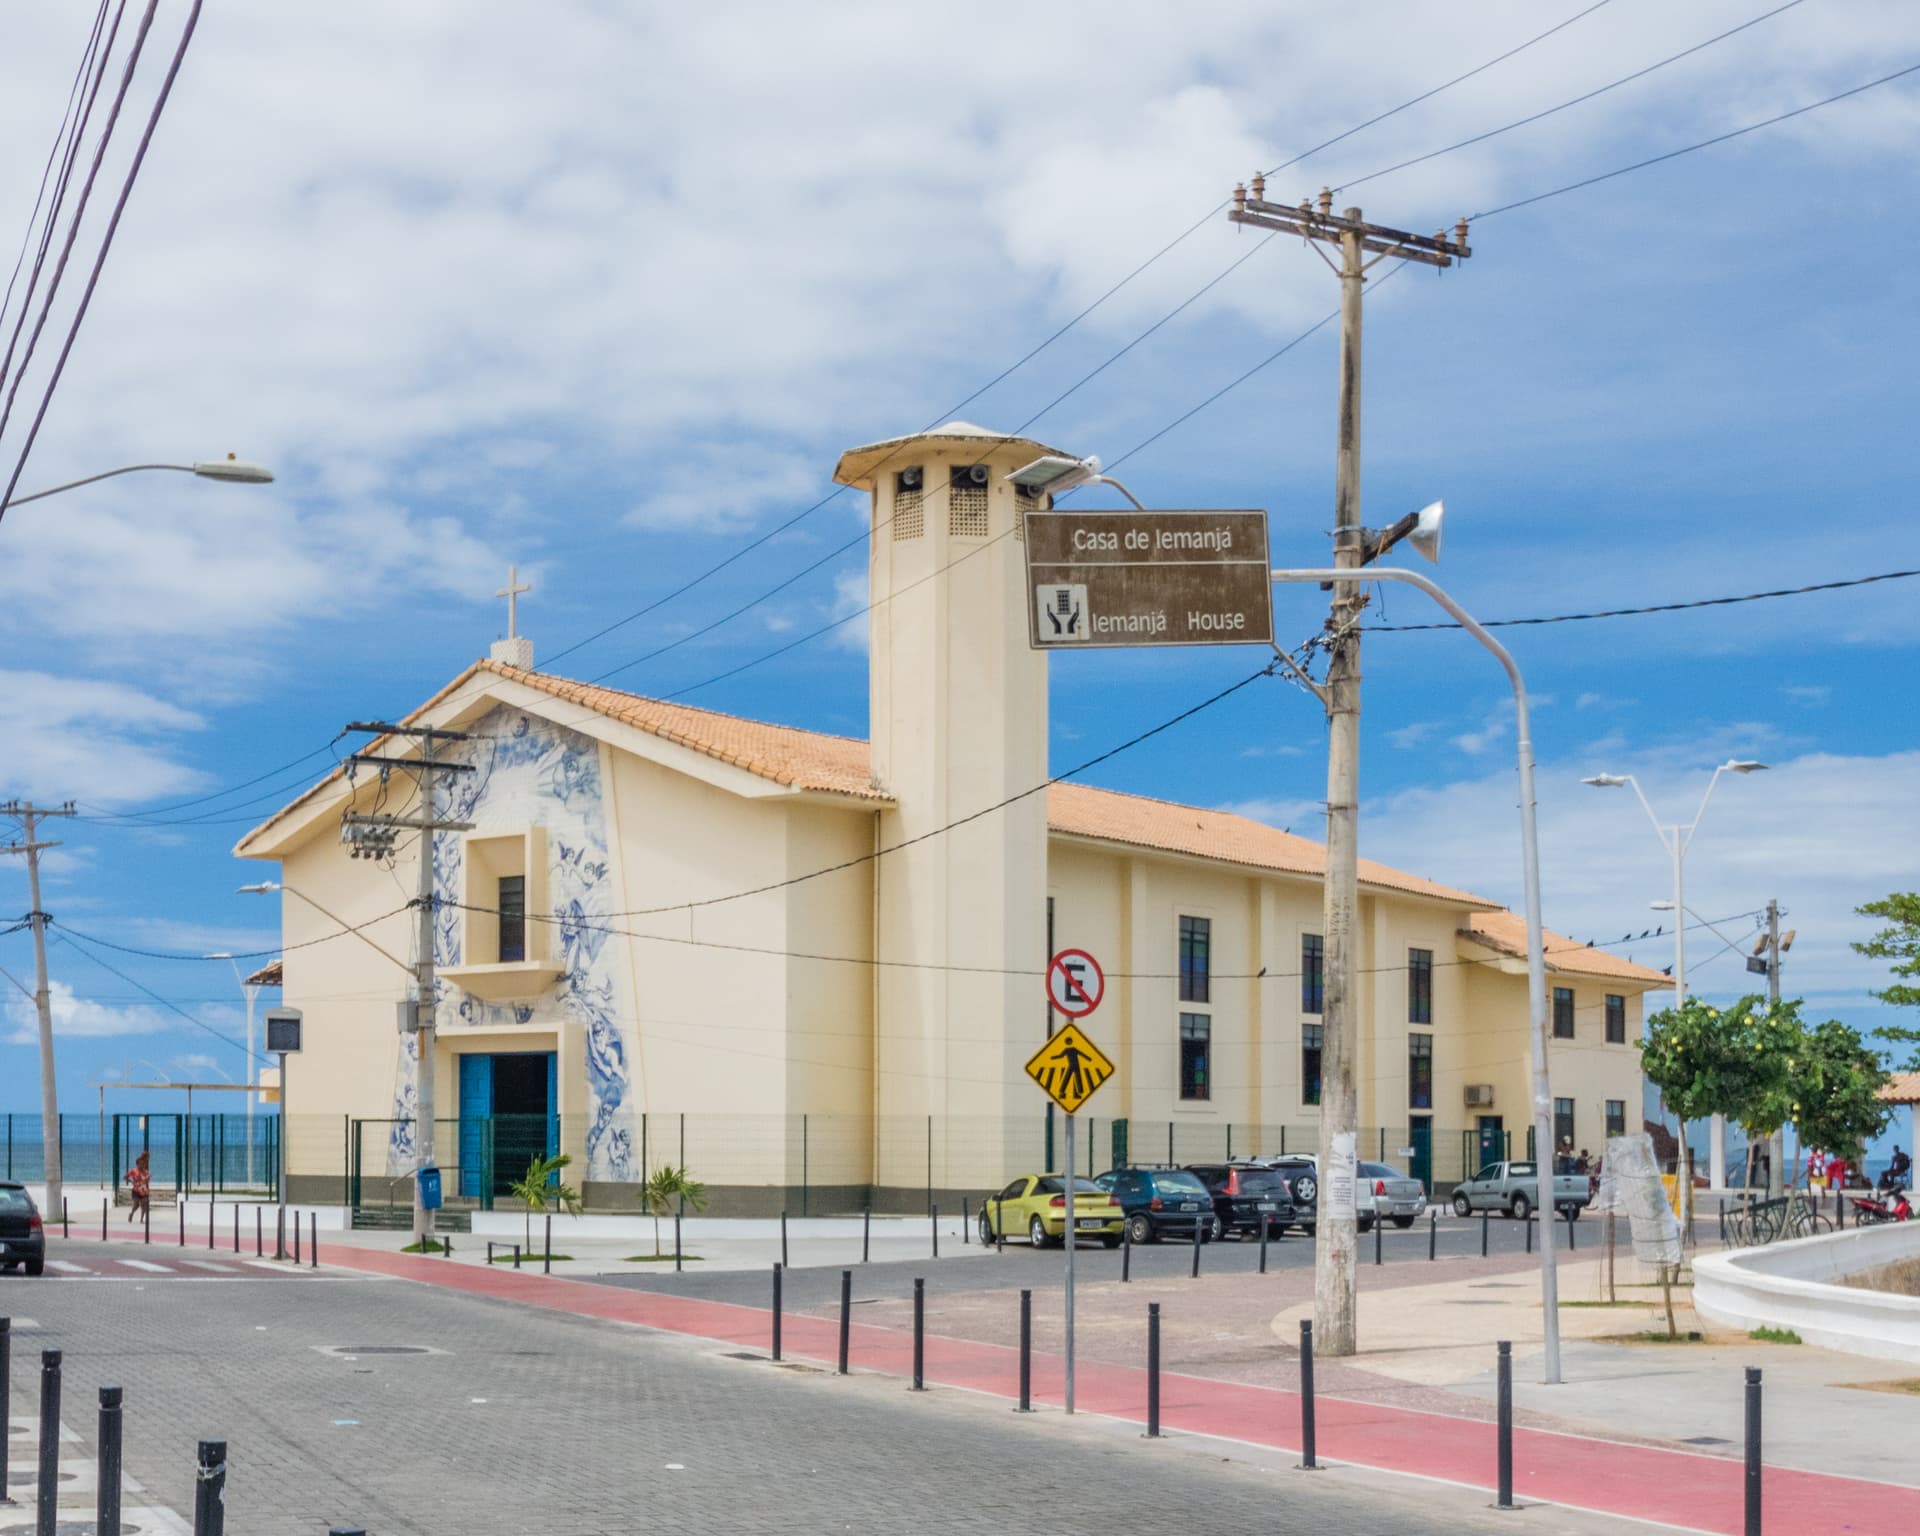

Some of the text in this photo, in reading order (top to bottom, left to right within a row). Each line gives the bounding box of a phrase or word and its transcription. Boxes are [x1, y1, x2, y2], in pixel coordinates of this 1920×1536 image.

[1074, 526, 1232, 552] Casa de Iemanjá
[1093, 610, 1245, 635] Iemanjá House
[1065, 964, 1086, 1002] E
